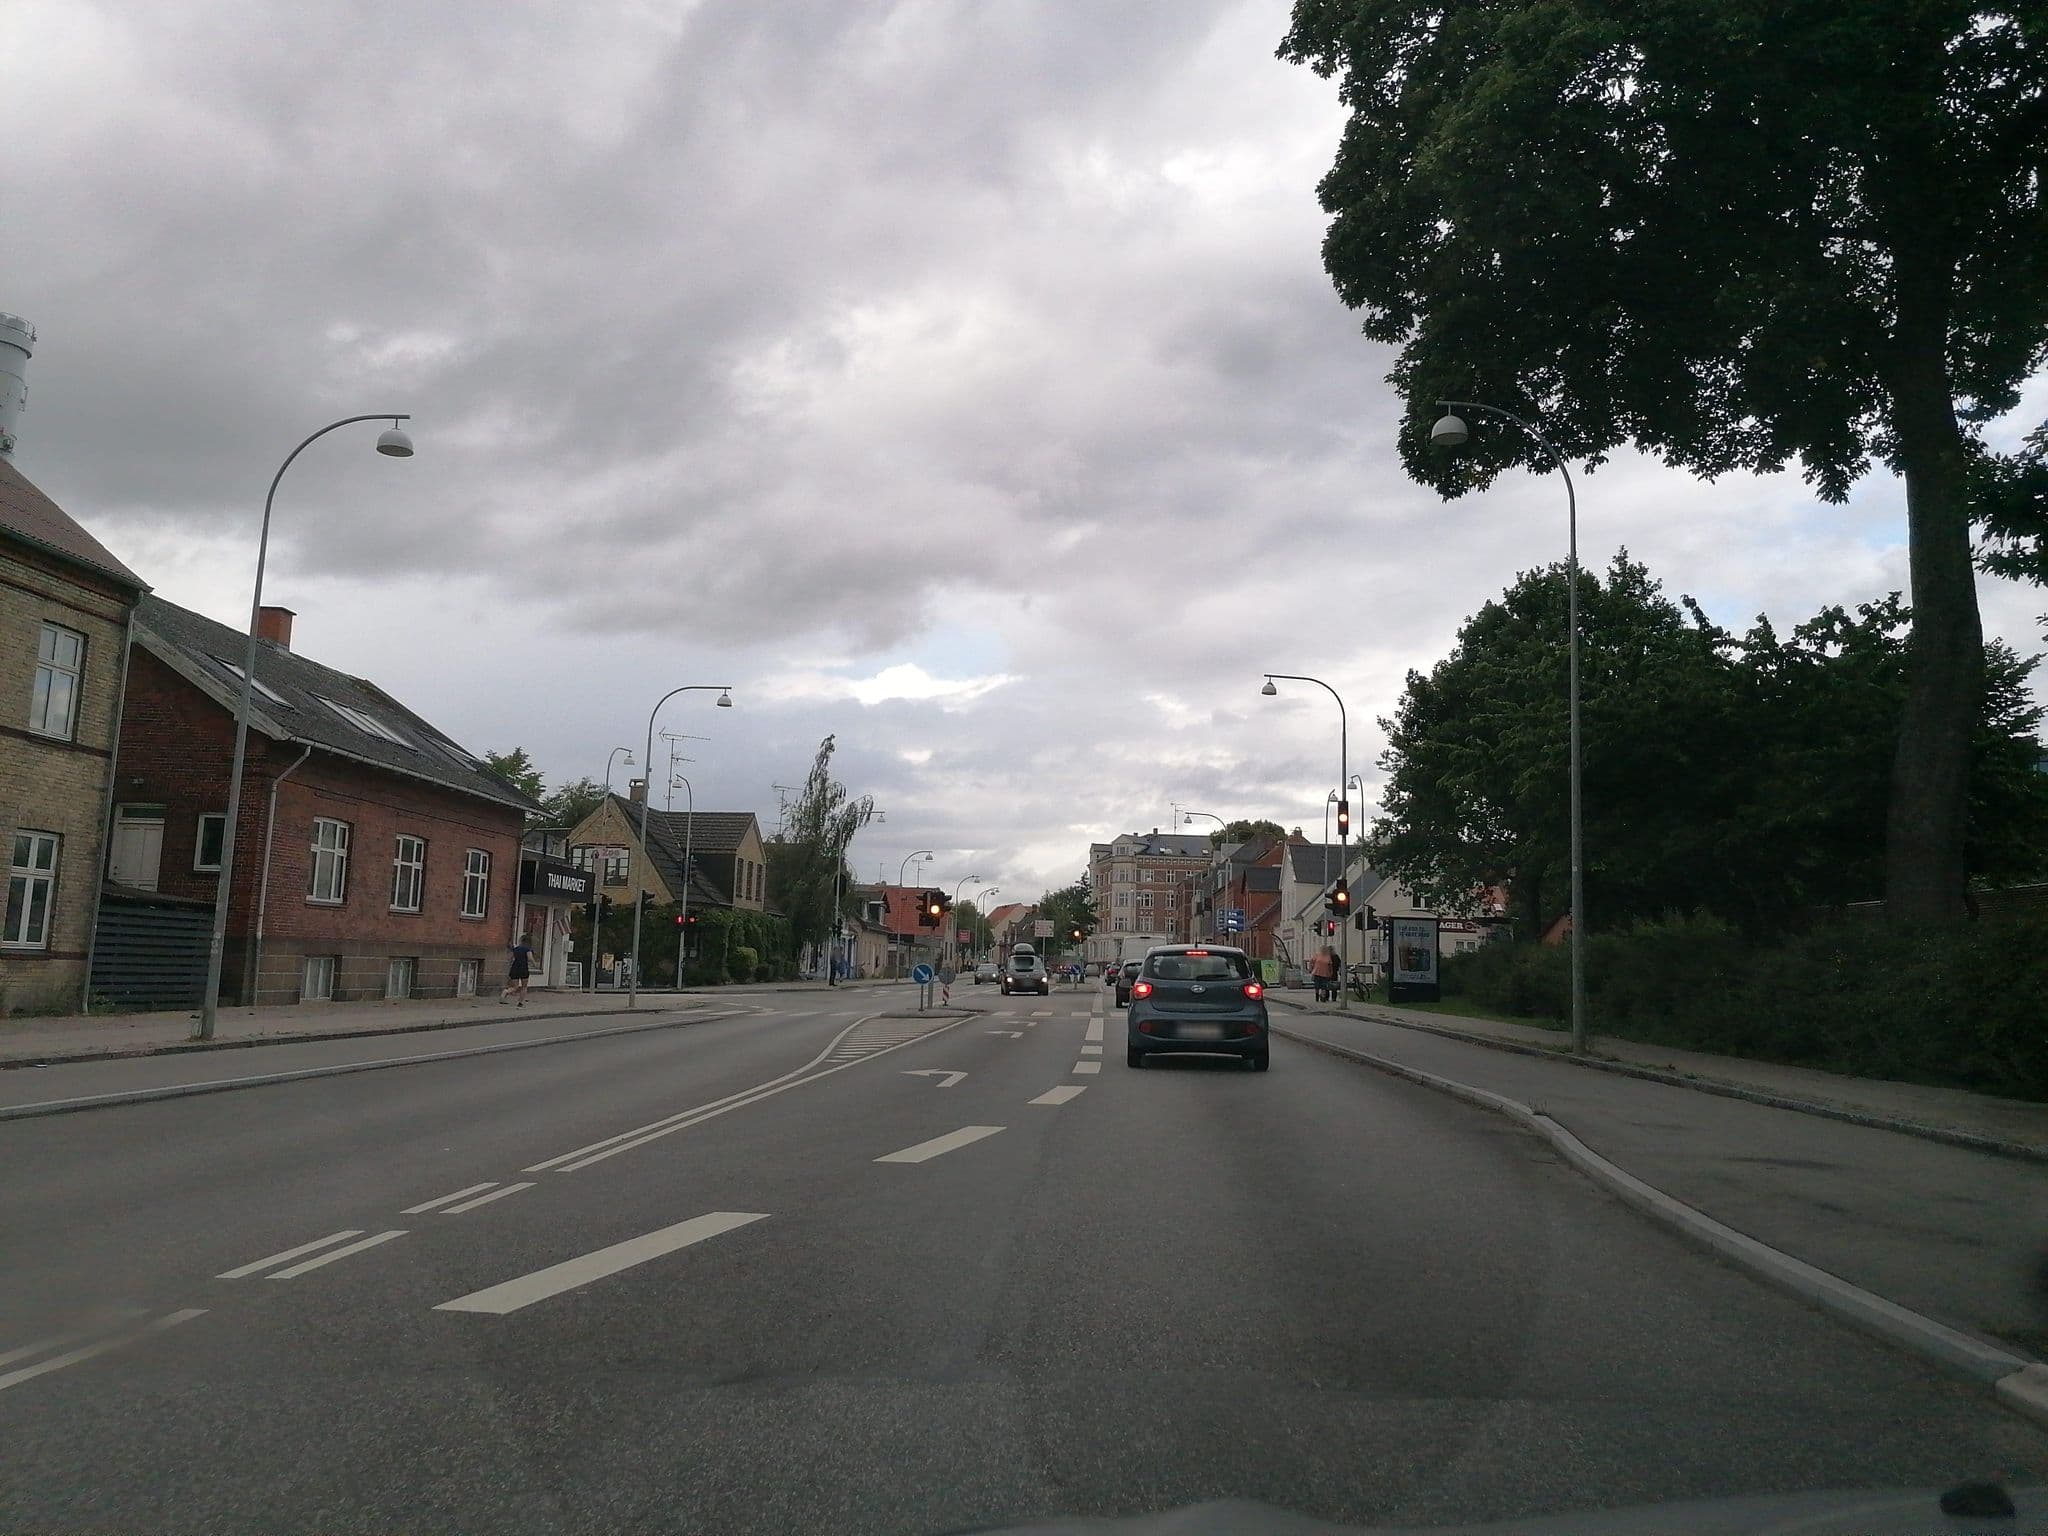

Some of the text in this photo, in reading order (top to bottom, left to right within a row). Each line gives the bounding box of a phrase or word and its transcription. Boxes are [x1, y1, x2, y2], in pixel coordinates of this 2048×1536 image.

[548, 873, 586, 892] THAI MARKET
[1439, 921, 1463, 929] AGER
